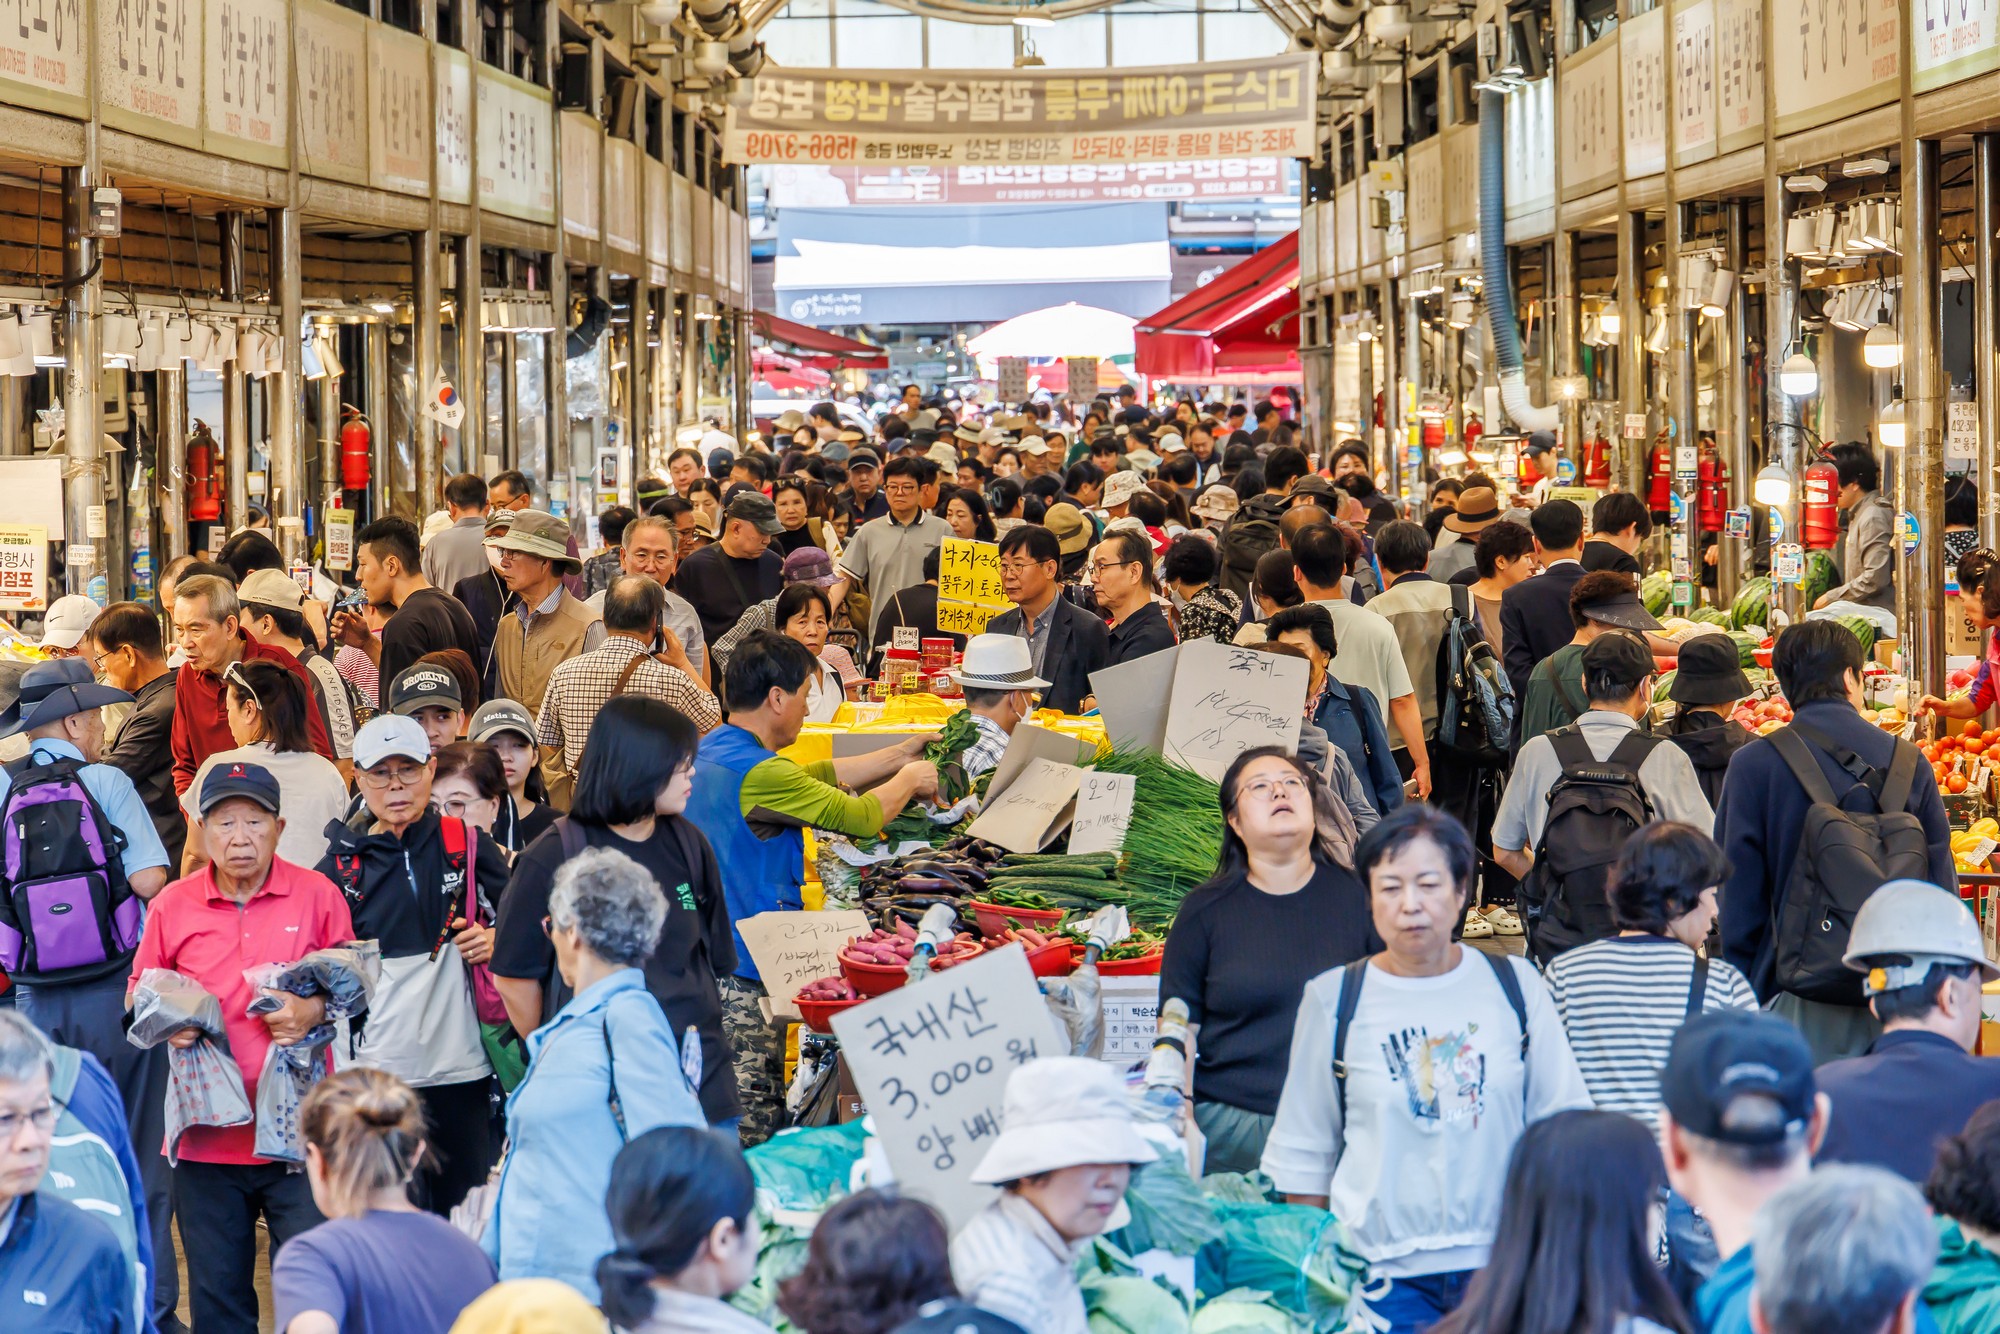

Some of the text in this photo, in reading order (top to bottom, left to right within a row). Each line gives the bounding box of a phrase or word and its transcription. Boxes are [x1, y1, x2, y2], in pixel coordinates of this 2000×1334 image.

[221, 2, 278, 117] 한농상회
[320, 665, 348, 738] CONFIDENCE
[402, 671, 450, 691] BROOKLYN
[483, 712, 508, 724] Matin
[866, 986, 998, 1057] 국내산
